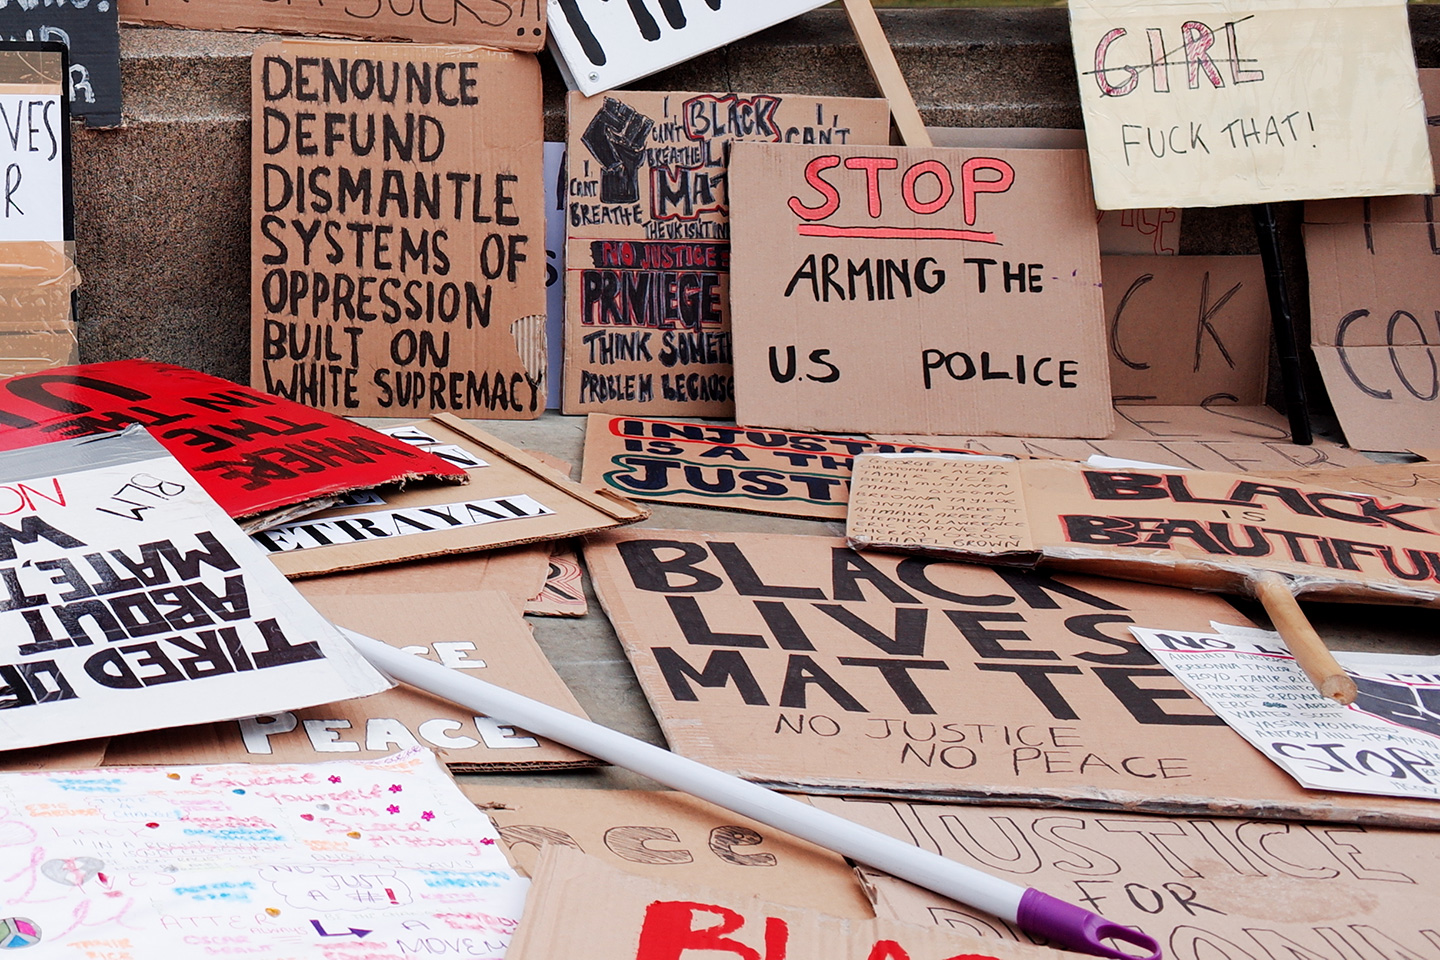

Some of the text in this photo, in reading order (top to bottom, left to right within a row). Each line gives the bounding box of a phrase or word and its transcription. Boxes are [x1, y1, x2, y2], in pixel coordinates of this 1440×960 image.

[262, 57, 480, 106] DENOUNCE
[1093, 21, 1264, 98] GIRL
[264, 107, 445, 162] DEFUND
[1121, 111, 1317, 166] FUCK THAT!
[262, 162, 520, 226] DISMANTLE
[787, 154, 1015, 225] STOP
[261, 215, 527, 284] SYSTEMS OF
[262, 269, 492, 329] OPPRESSION
[785, 253, 1044, 303] ARMING THE
[262, 319, 450, 369] BUILT ON
[767, 344, 1079, 389] U.S POLICE
[264, 361, 545, 412] WHITE SUPREMACY
[84, 618, 328, 690] TIRED
[774, 713, 1086, 749] NO JUSTICE
[900, 742, 1192, 780] NO PEACE
